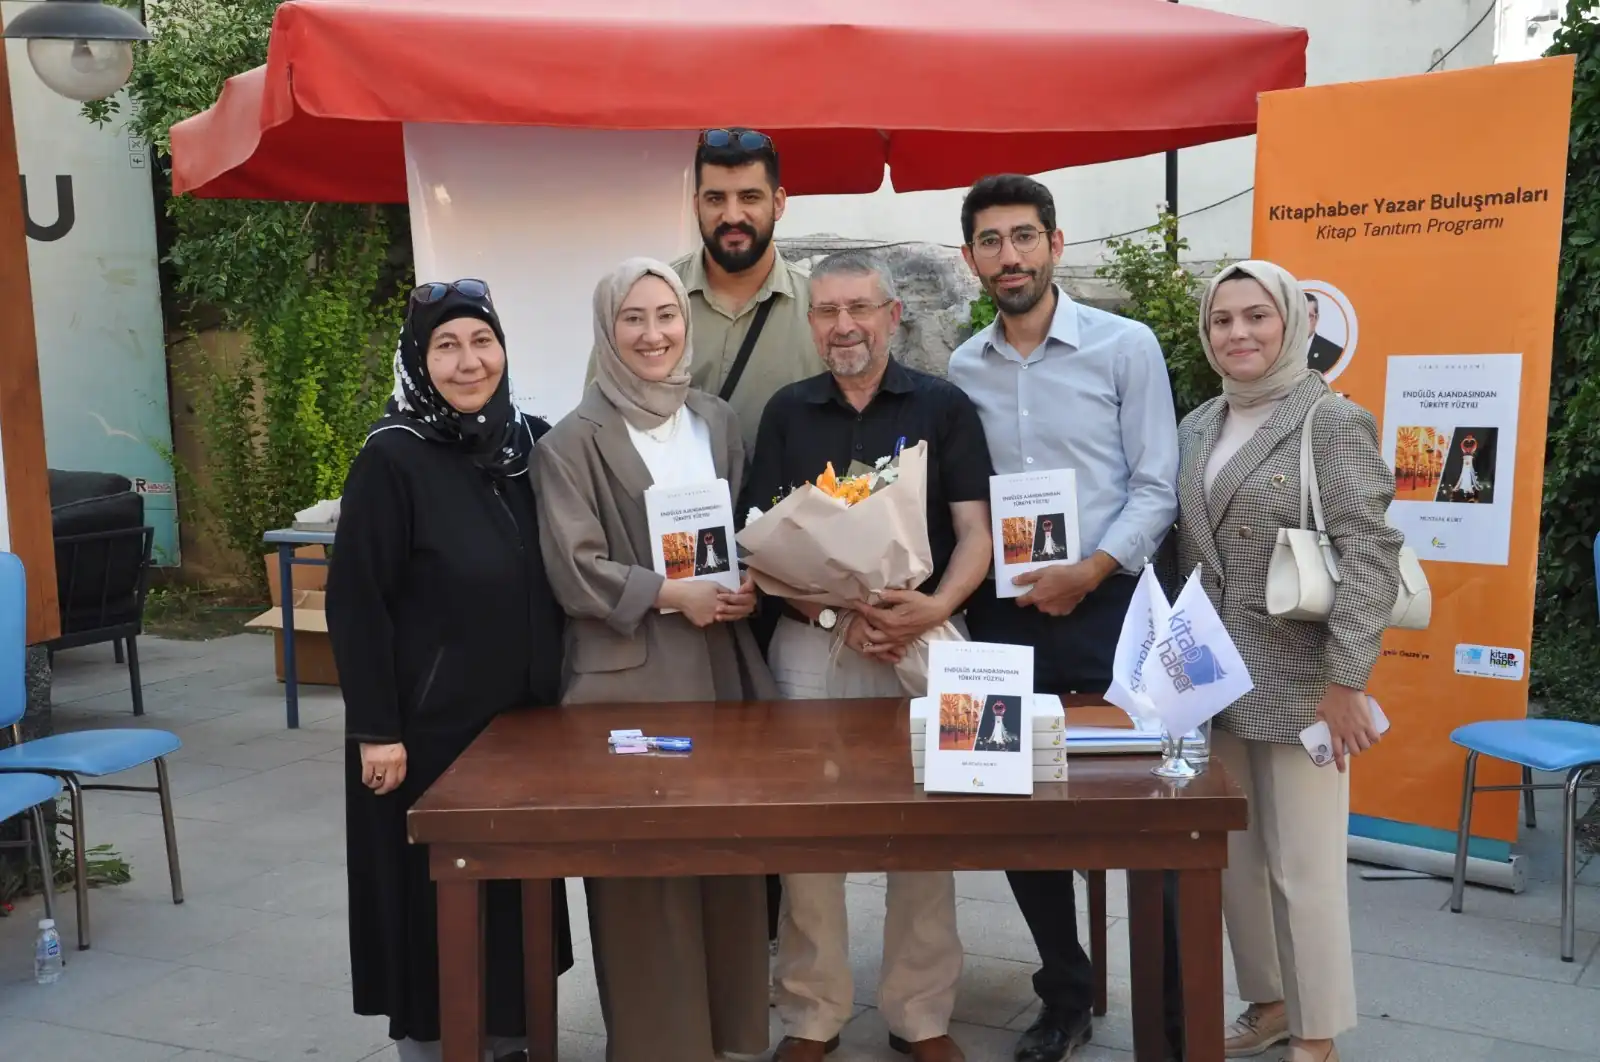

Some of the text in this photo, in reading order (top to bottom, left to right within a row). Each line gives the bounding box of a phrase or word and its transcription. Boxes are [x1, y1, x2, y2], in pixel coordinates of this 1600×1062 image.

[1269, 187, 1549, 223] Kitaphaber Yazar Buluşmaları
[1316, 217, 1504, 242] Kitap Tanıtım Programı
[1402, 389, 1497, 399] ENDÜLÜS AJANDASINDAN
[1419, 399, 1449, 409] TÜRKİYE
[1168, 609, 1202, 663] kitap
[1156, 637, 1195, 694] haber
[1489, 656, 1519, 667] haber
